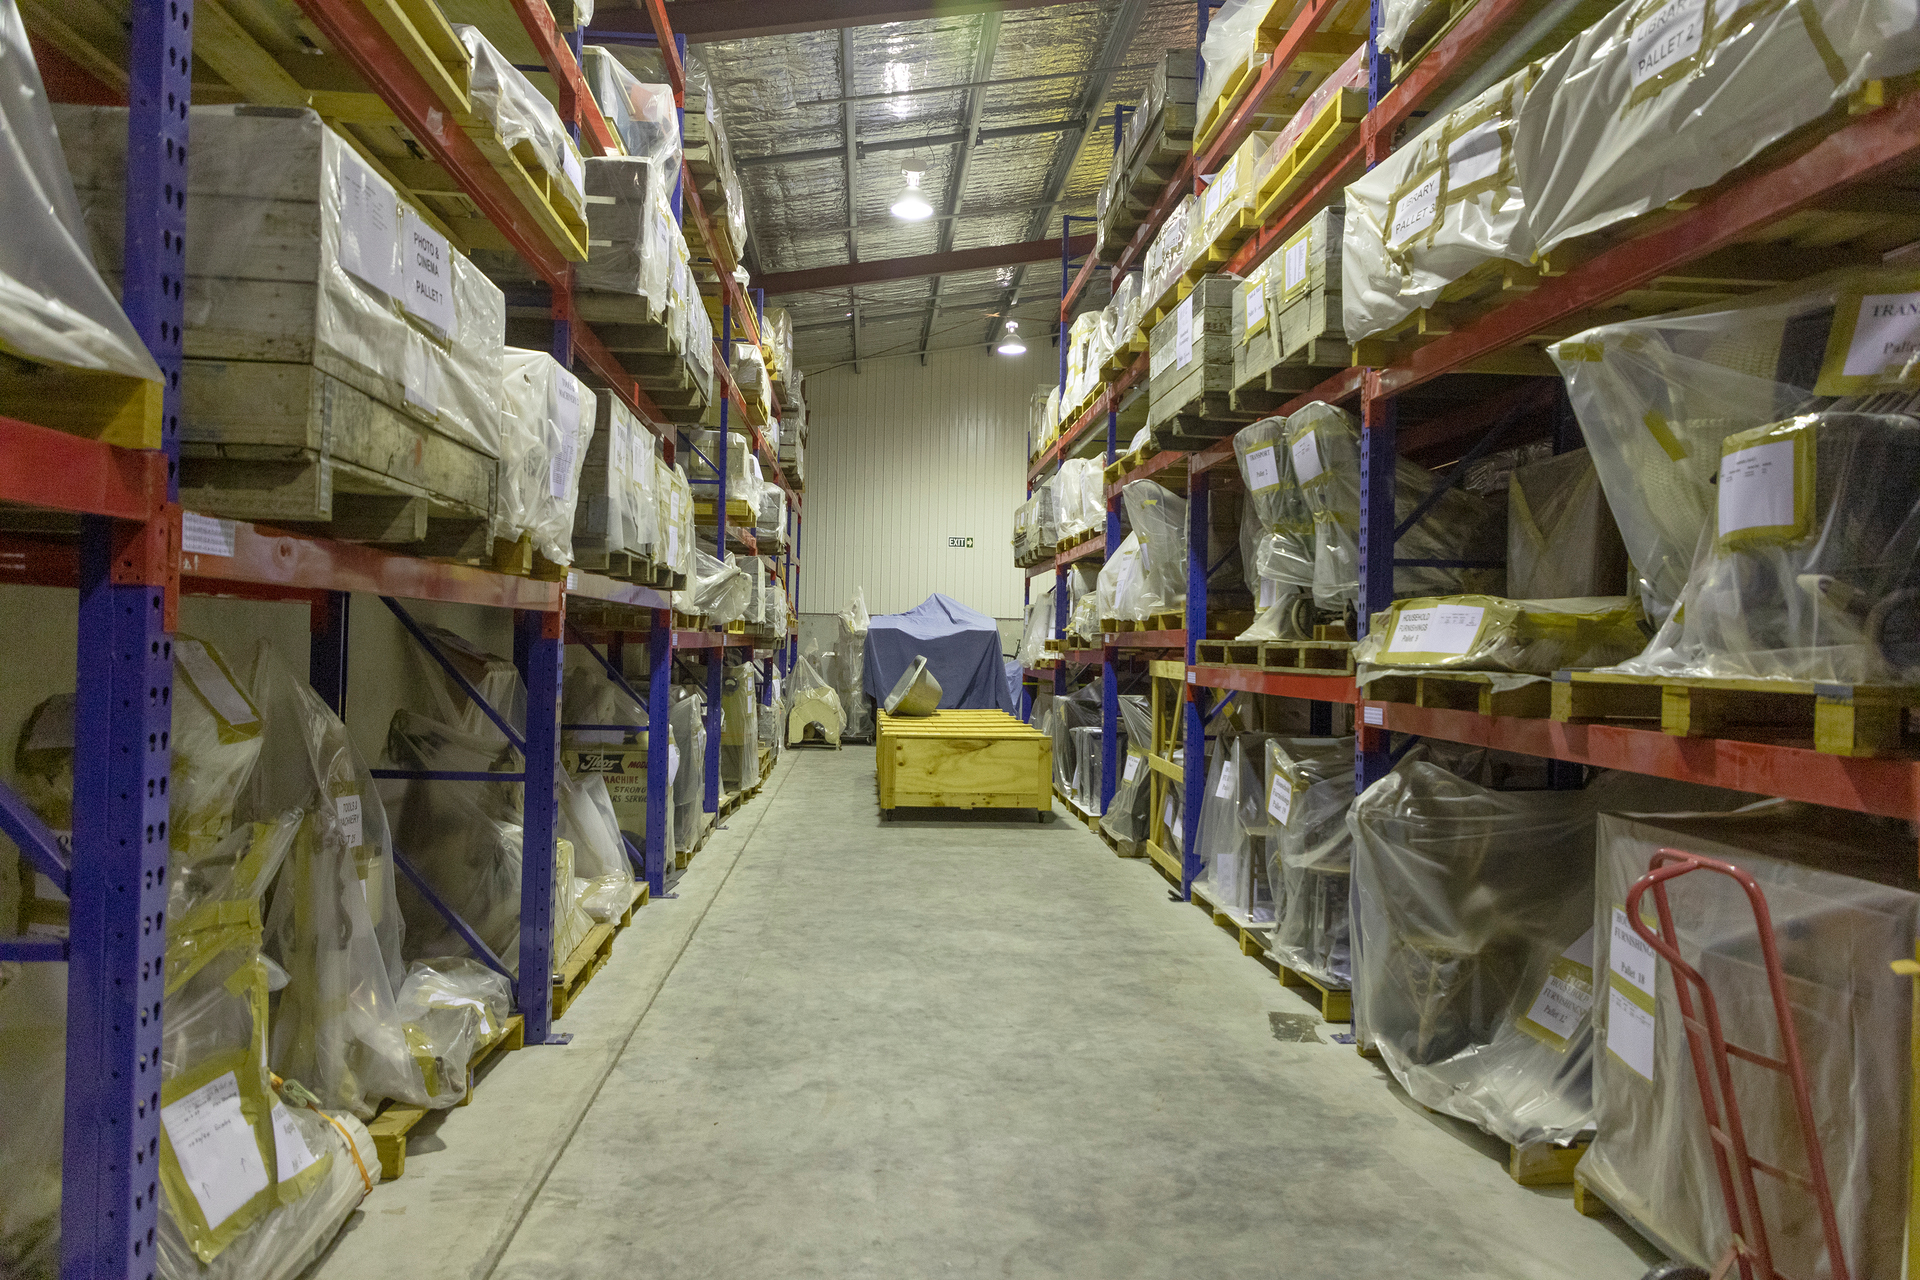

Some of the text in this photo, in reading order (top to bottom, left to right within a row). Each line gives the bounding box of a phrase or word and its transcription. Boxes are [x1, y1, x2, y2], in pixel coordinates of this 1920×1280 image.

[1637, 0, 1692, 43] LIBRAR
[1637, 23, 1695, 77] PALLET 2
[1401, 180, 1436, 212] LIBRARY
[1395, 205, 1430, 235] PALLET
[413, 231, 440, 260] PHOTO &
[416, 252, 440, 278] CINEMA
[415, 279, 439, 304] PALLET
[1249, 449, 1270, 461] TRANSPORT
[950, 538, 964, 546] EXIT
[1403, 612, 1431, 622] HOUSEHOLD
[1399, 623, 1429, 632] FURNISHINGS
[580, 754, 620, 771] Thor
[603, 775, 639, 785] MACHINE
[613, 786, 647, 794] STRONG
[1620, 960, 1636, 980] Pallet
